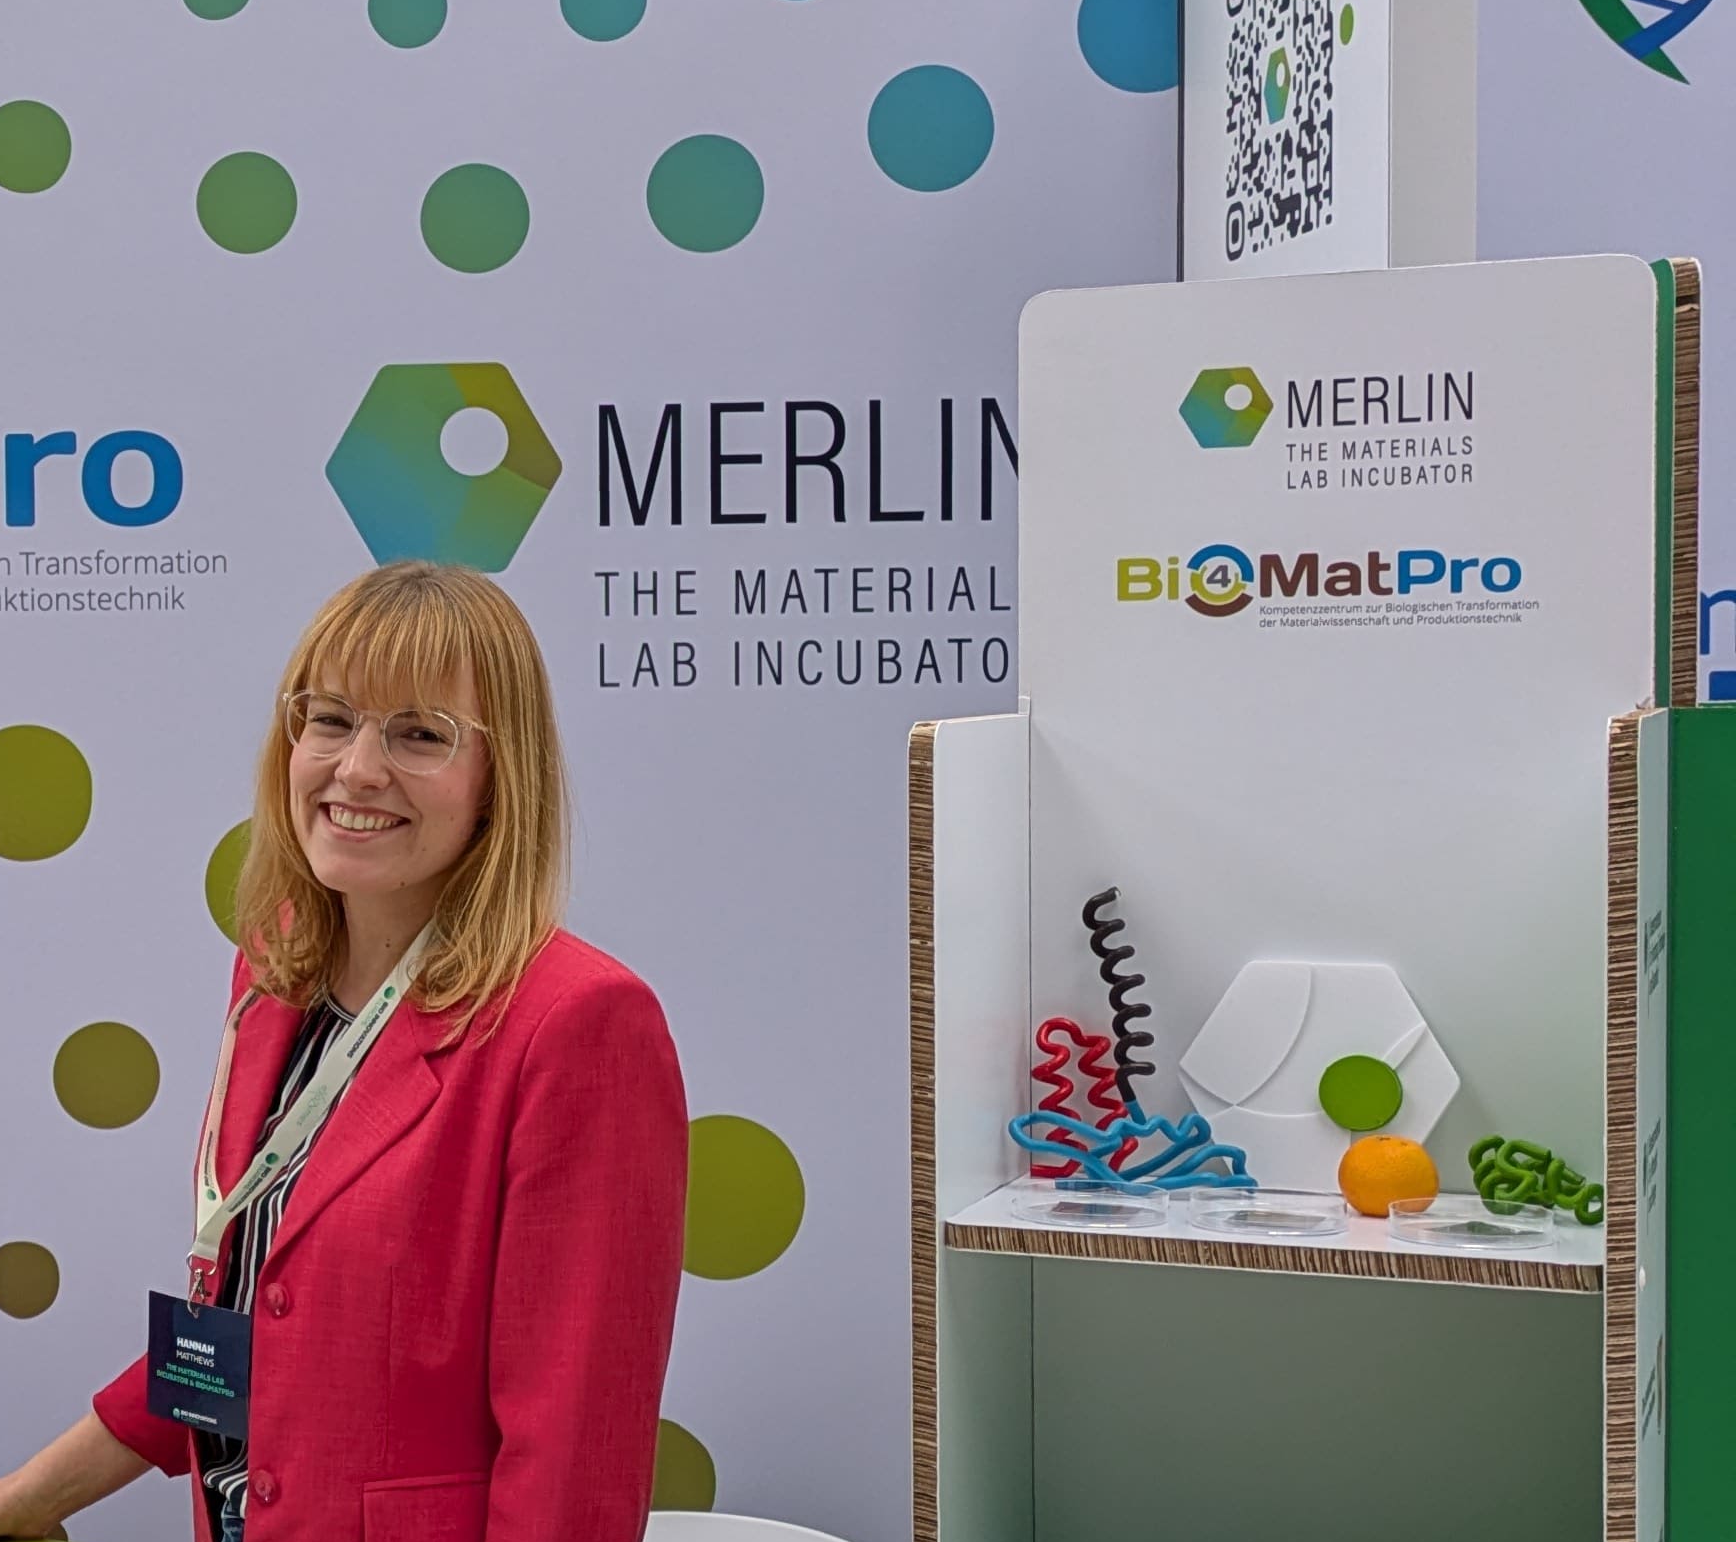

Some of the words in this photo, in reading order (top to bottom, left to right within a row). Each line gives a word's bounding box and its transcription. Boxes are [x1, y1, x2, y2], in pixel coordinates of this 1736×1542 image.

[1286, 370, 1476, 429] MERLIN
[597, 397, 1020, 528] MERLIN
[1286, 441, 1328, 463] THE
[1342, 435, 1474, 461] MATERIALS
[1286, 467, 1329, 490] LAB
[1341, 462, 1475, 488] INCUBATOR
[19, 548, 228, 578] Transformation
[594, 570, 698, 617] THE
[733, 565, 1012, 614] MATERIAL
[1259, 602, 1363, 617] Kompetenzzentrum
[1365, 604, 1383, 614] zur
[1385, 599, 1453, 616] Biologischen
[1456, 597, 1540, 612] Transformation
[1259, 617, 1278, 629] der
[1280, 613, 1391, 629] Materialwissenschaft
[1392, 614, 1414, 626] und
[1417, 610, 1523, 626] Produktionstechnik
[598, 641, 698, 688] LAB
[734, 637, 1011, 686] INCUBATO
[175, 1350, 215, 1368] MATTHEWS
[176, 1336, 215, 1356] HANNAH
